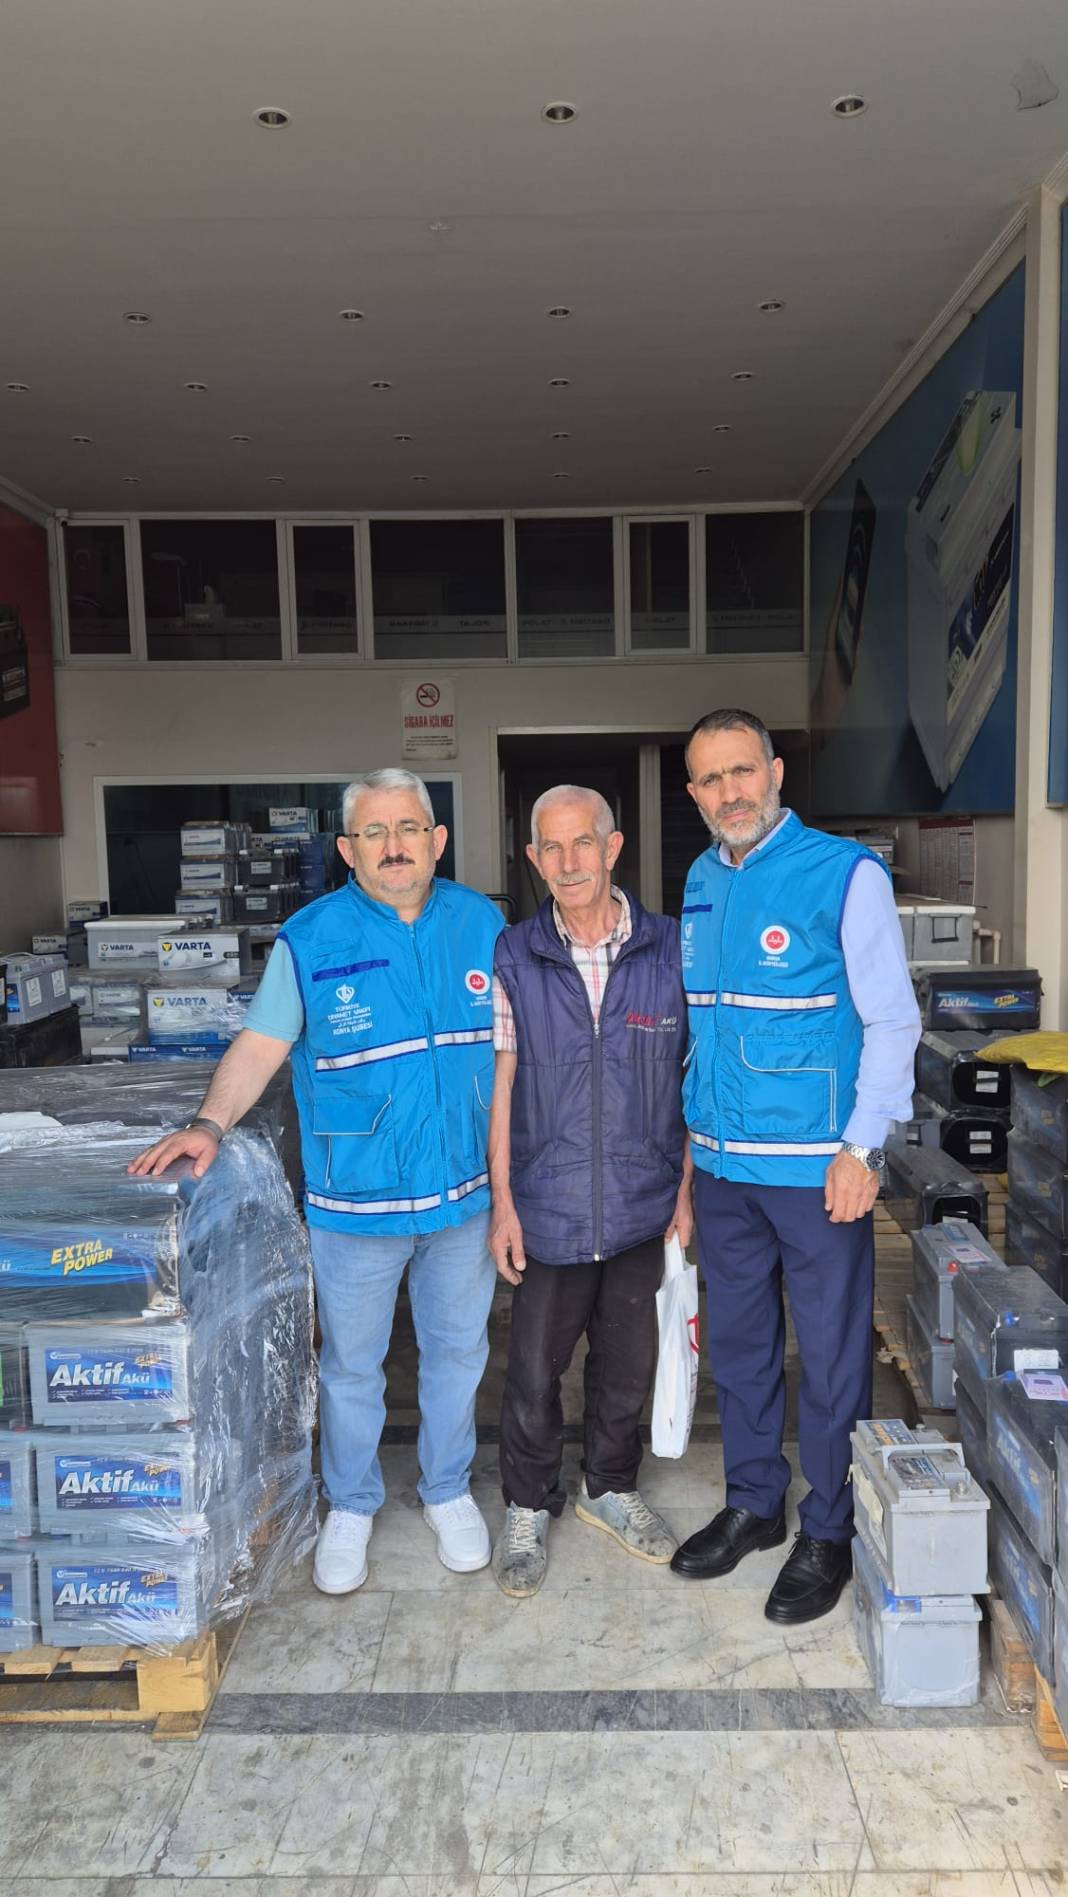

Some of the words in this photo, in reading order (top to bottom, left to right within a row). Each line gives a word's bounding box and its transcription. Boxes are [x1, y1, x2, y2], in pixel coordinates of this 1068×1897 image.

[109, 943, 134, 951] VARTA
[174, 942, 211, 951] VARTA
[167, 997, 207, 1007] VARTA
[938, 997, 969, 1008] Aktif
[51, 1239, 103, 1265] EXTRA
[63, 1247, 113, 1276] POWER
[49, 1361, 125, 1387] Aktif
[121, 1372, 150, 1385] Akü
[58, 1469, 135, 1495] Aktif
[129, 1480, 159, 1492] Akü
[54, 1581, 131, 1606] Aktif
[127, 1591, 156, 1604] Akü
